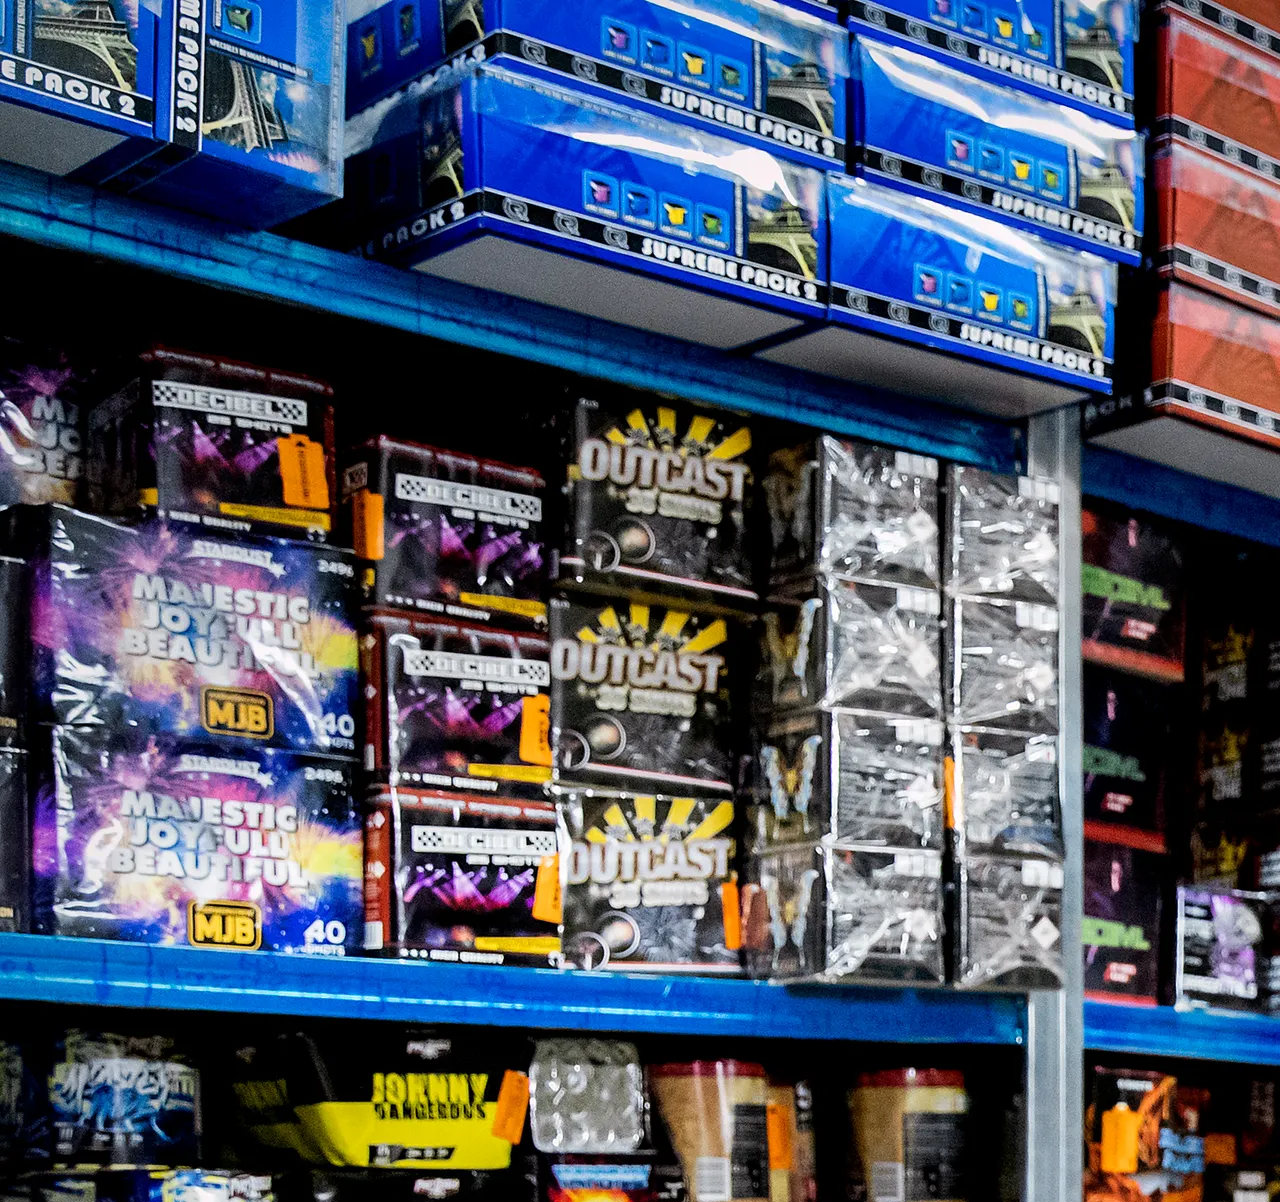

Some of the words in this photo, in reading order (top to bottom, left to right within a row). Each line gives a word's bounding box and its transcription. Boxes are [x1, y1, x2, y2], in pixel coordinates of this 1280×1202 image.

[25, 67, 110, 106] PACK
[119, 96, 136, 116] 2
[177, 37, 199, 114] PACK
[978, 47, 1059, 89] SUPREME
[1061, 76, 1109, 106] PACK
[176, 117, 196, 133] 2
[660, 86, 756, 132] SUPREME
[759, 118, 819, 154] PACK
[821, 137, 835, 157] 2
[992, 191, 1070, 230] SUPREME
[1072, 216, 1120, 247] PACK
[641, 238, 738, 279] SUPREME
[741, 265, 801, 297] PACK
[803, 283, 818, 301] 2
[960, 323, 1039, 361] SUPREME
[1041, 344, 1091, 375] PACK
[176, 388, 276, 415] DECIBEL
[580, 438, 749, 500] OUTCAST
[133, 573, 310, 624] MAJESTIC
[143, 602, 302, 650] JOYFULL
[550, 638, 724, 693] OUTCAST
[209, 700, 268, 733] MJB
[121, 790, 298, 832] MAJESTIC
[130, 819, 289, 859] JOYFULL
[568, 839, 731, 884] OUTCAST
[110, 849, 311, 889] BEAUTIFUL
[196, 913, 256, 945] MJB
[304, 920, 346, 944] 40
[371, 1072, 488, 1104] JOHNNY
[375, 1103, 486, 1120] DANGEROUS
